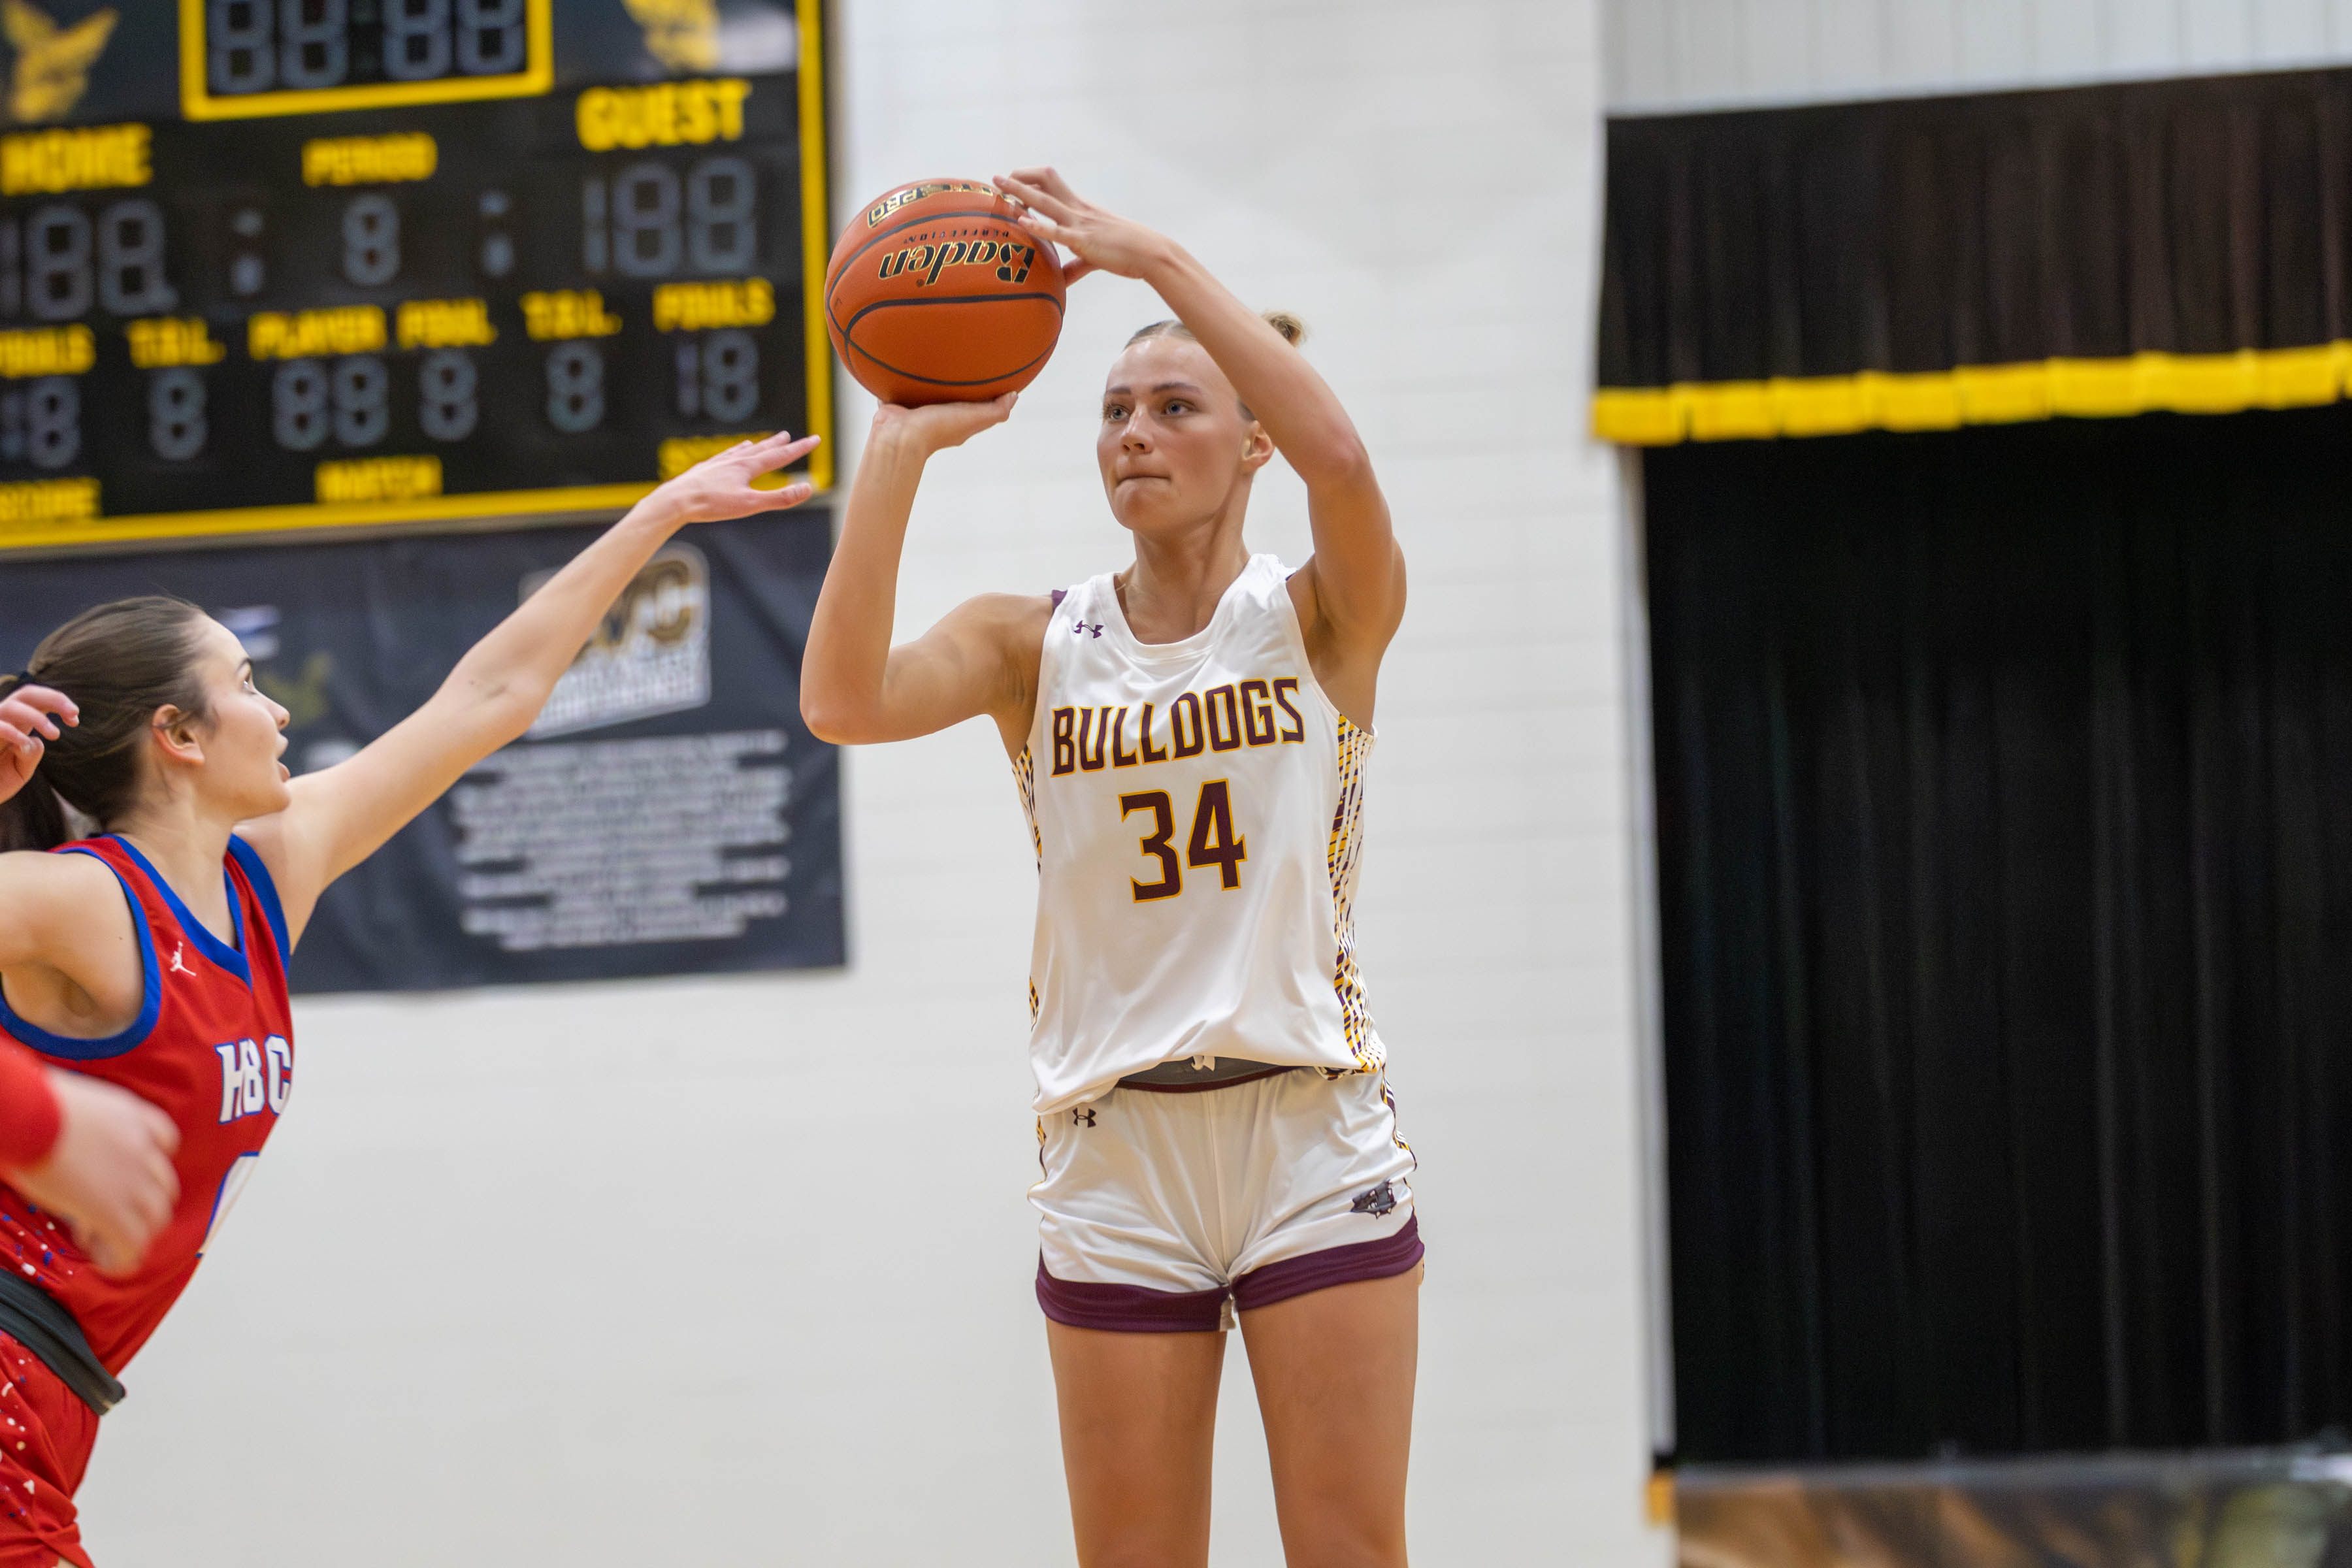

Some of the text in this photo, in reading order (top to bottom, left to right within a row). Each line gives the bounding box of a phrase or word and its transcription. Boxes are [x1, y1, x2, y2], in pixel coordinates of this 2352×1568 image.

[576, 78, 752, 151] GUEST
[0, 123, 152, 195] HOME
[867, 187, 923, 229] PRO
[879, 240, 1036, 288] Baden
[248, 304, 387, 361] PLAYER
[654, 278, 776, 332] FOULS
[0, 323, 97, 378] OULS
[1050, 676, 1305, 777] BULLDOGS
[1118, 778, 1248, 903] 34
[214, 1033, 292, 1125] HBC
